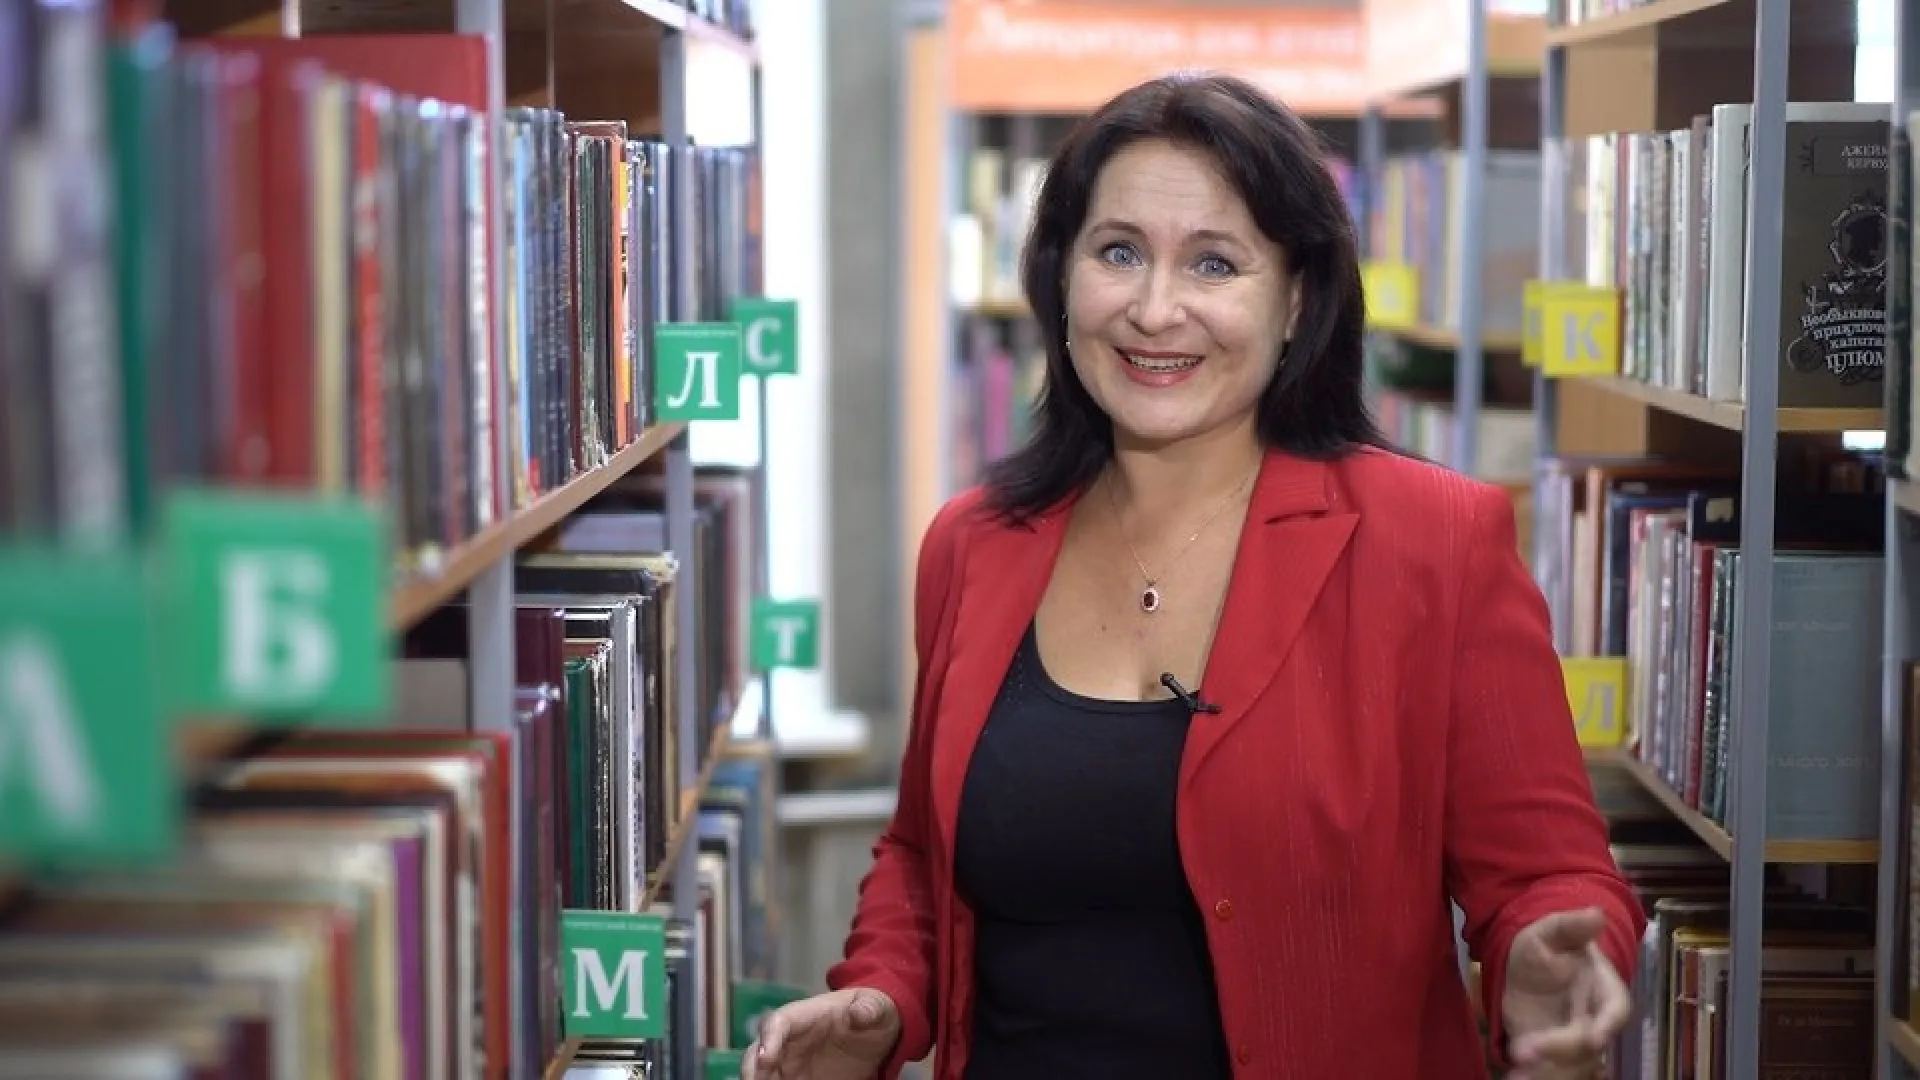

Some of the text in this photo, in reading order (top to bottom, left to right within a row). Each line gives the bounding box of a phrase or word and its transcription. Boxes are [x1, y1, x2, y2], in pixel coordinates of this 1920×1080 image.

[745, 316, 782, 369] С
[1563, 311, 1604, 362] К
[666, 350, 722, 409] Л
[219, 545, 339, 704] Б
[764, 616, 807, 662] Т
[1577, 681, 1617, 732] Л
[571, 946, 649, 1020] М
